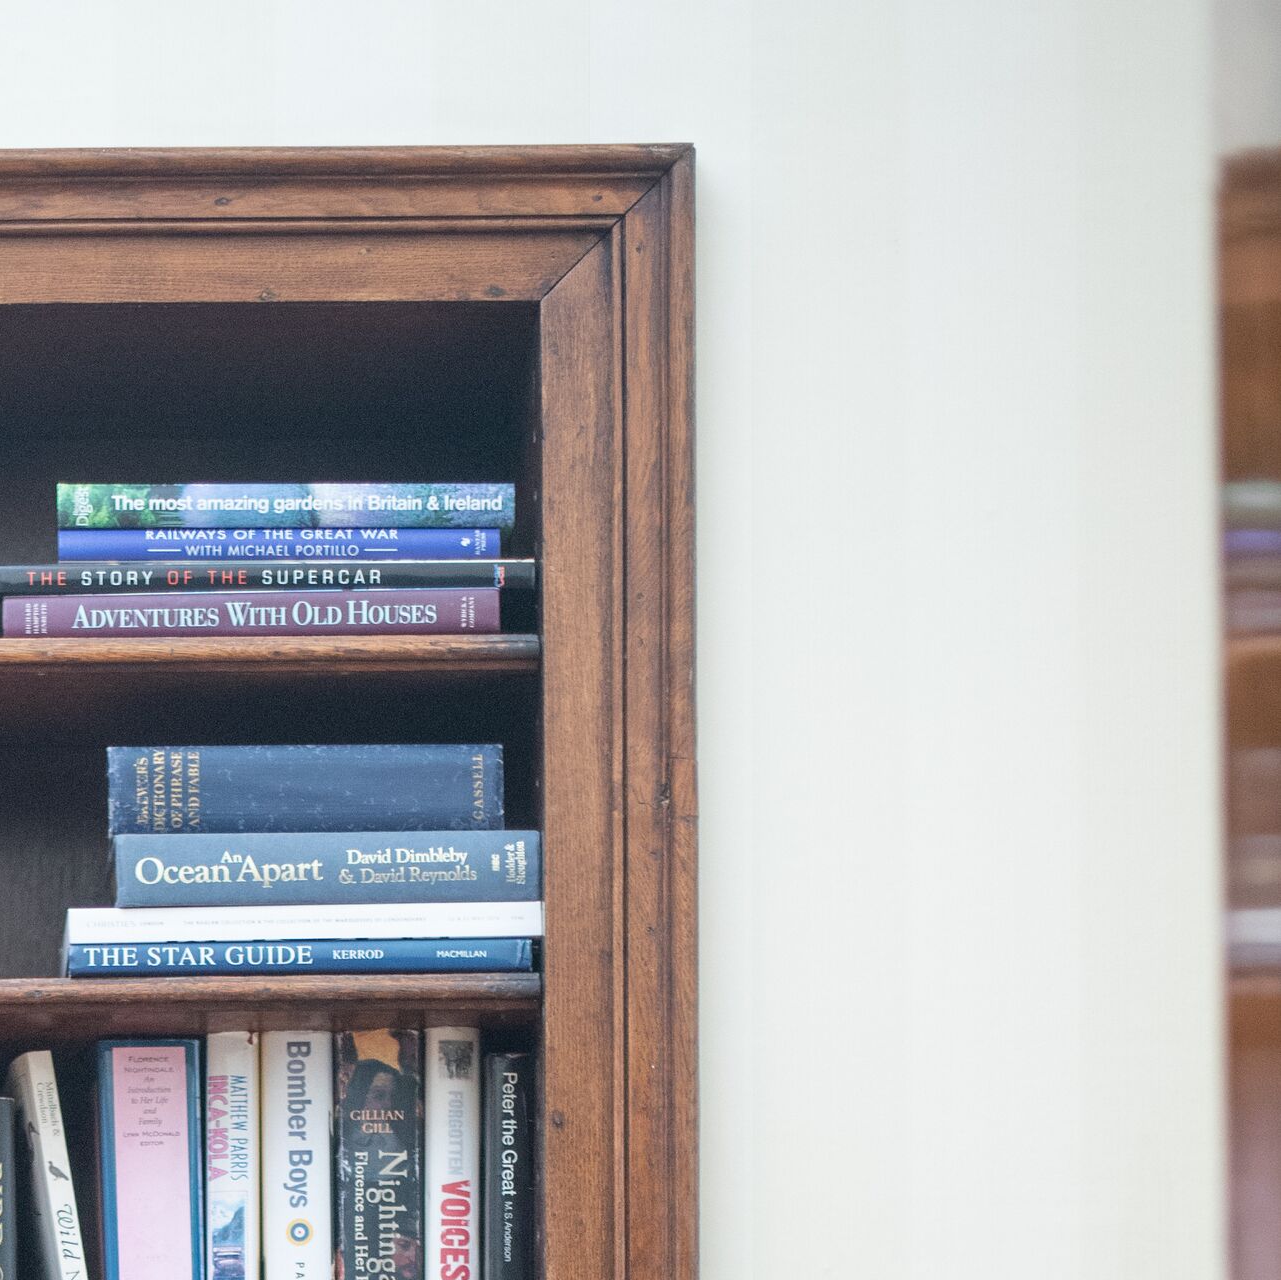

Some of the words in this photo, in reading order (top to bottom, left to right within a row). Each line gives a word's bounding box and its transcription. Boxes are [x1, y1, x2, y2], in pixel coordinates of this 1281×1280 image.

[111, 495, 144, 511] The
[149, 496, 191, 511] most
[194, 496, 269, 514] amazing
[273, 496, 342, 514] gardens
[347, 496, 362, 511] in
[368, 495, 424, 511] Britain
[427, 495, 440, 511] &
[444, 494, 502, 511] Ireland
[146, 530, 226, 541] RAILWAYS
[233, 530, 255, 540] OF
[263, 530, 293, 540] THE
[300, 530, 352, 540] GREAT
[360, 530, 399, 541] WAR
[185, 545, 221, 557] WITH
[227, 544, 289, 557] MICHAEL
[295, 543, 359, 556] PORTILLO
[27, 571, 67, 586] THE
[80, 571, 153, 586] STORY
[167, 571, 193, 585] OF
[207, 570, 247, 585] THE
[261, 569, 382, 585] SUPERCAR
[71, 604, 220, 629] ADVENTURES
[224, 602, 287, 627] WITH
[292, 601, 343, 626] OLD
[346, 600, 438, 626] HOUSES
[472, 753, 484, 820] CASSELL
[220, 851, 243, 864] An
[346, 850, 393, 865] David
[395, 847, 469, 866] Dimbleby
[134, 857, 232, 884] Ocean
[236, 855, 324, 888] Apart
[338, 868, 357, 885] &
[360, 867, 406, 884] David
[408, 864, 478, 885] Reynolds
[83, 946, 139, 967] THE
[147, 945, 216, 966] STAR
[224, 944, 315, 966] GUIDE
[332, 949, 384, 961] KERROD
[436, 949, 488, 958] MACMILLAN
[230, 1075, 249, 1132] MATTHEW
[286, 1041, 313, 1142] Bomber
[502, 1072, 518, 1117] Peter
[207, 1075, 229, 1182] INCA-KOLA
[350, 1109, 405, 1123] GILLIAN
[360, 1122, 394, 1135] GILL
[501, 1119, 518, 1146] the
[230, 1138, 249, 1181] PARRIS
[501, 1149, 518, 1196] Great
[283, 1150, 313, 1208] Boys
[354, 1151, 369, 1213] Florence
[56, 1203, 82, 1260] Wild
[354, 1215, 366, 1243] and
[355, 1246, 368, 1272] Her
